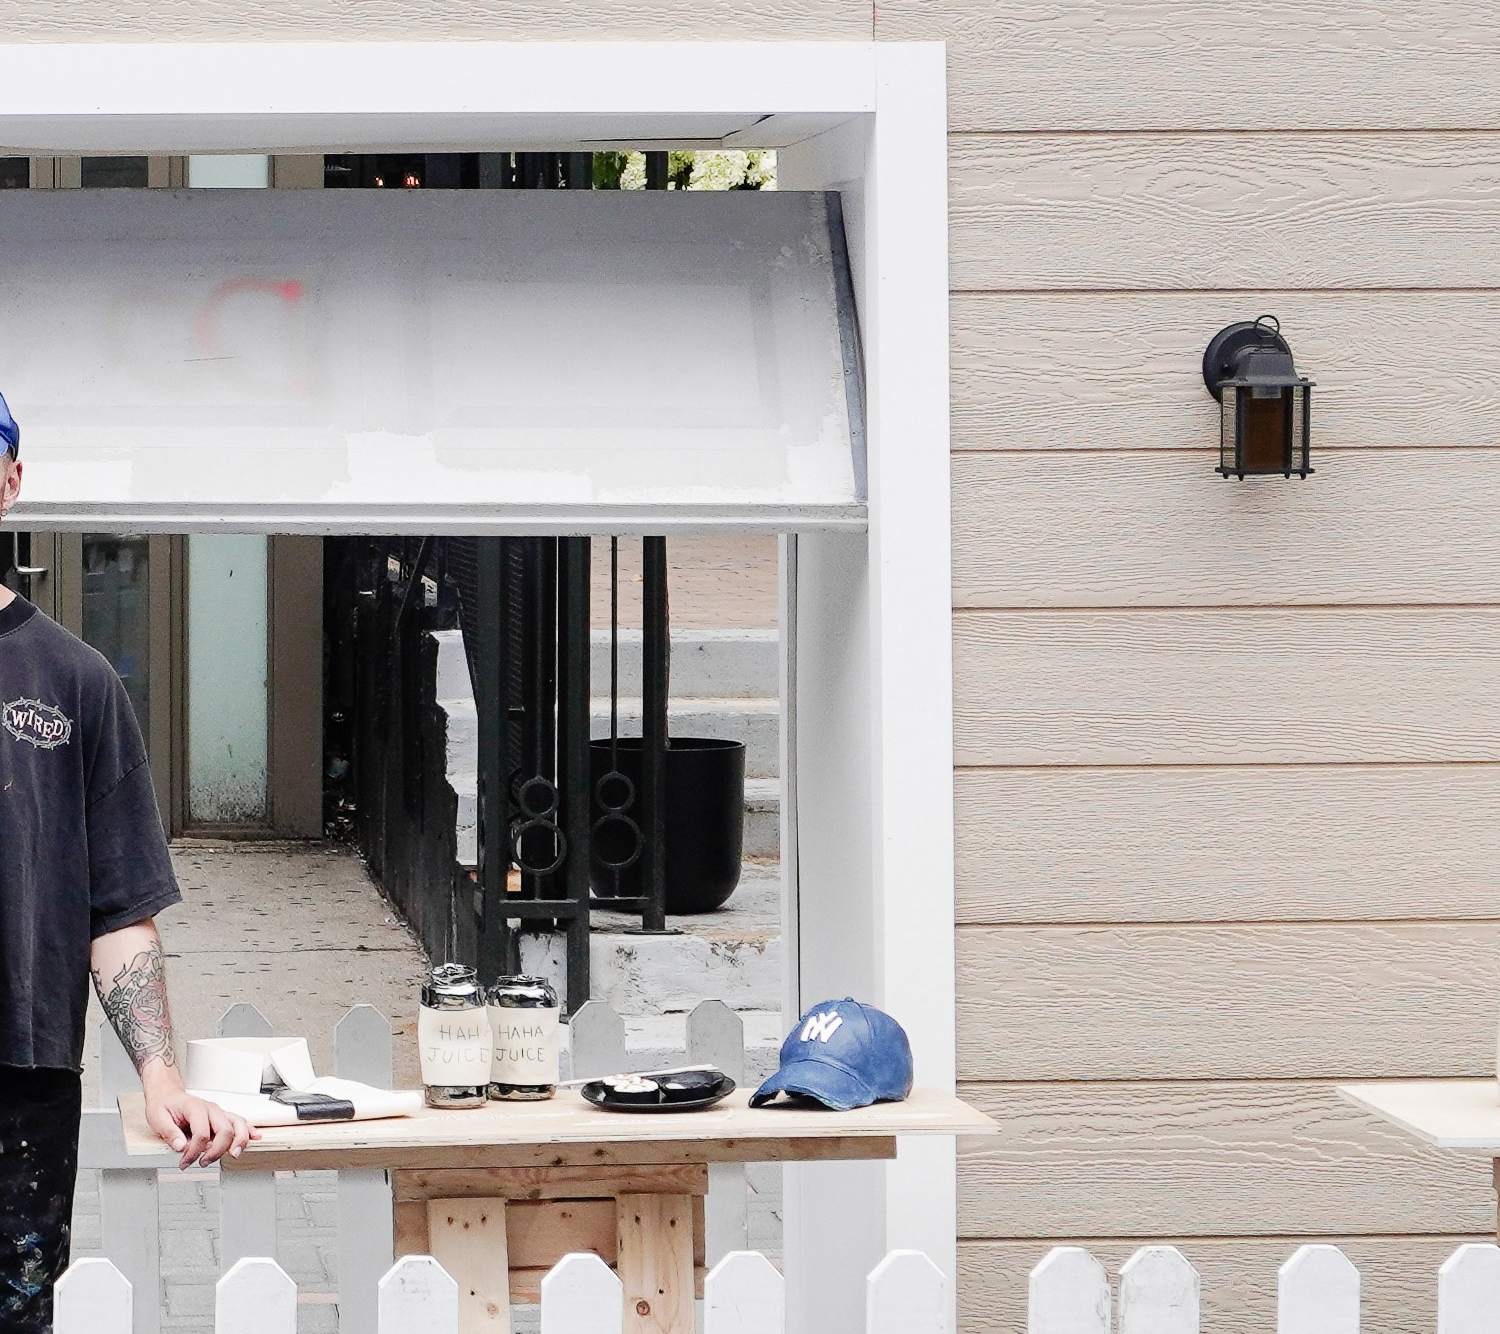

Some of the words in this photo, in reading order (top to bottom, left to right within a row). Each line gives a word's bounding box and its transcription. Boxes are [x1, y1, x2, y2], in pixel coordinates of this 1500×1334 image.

[12, 709, 64, 738] WIRED
[498, 1024, 543, 1040] HAHA
[428, 1047, 490, 1064] JUICE
[496, 1047, 545, 1063] JUICE
